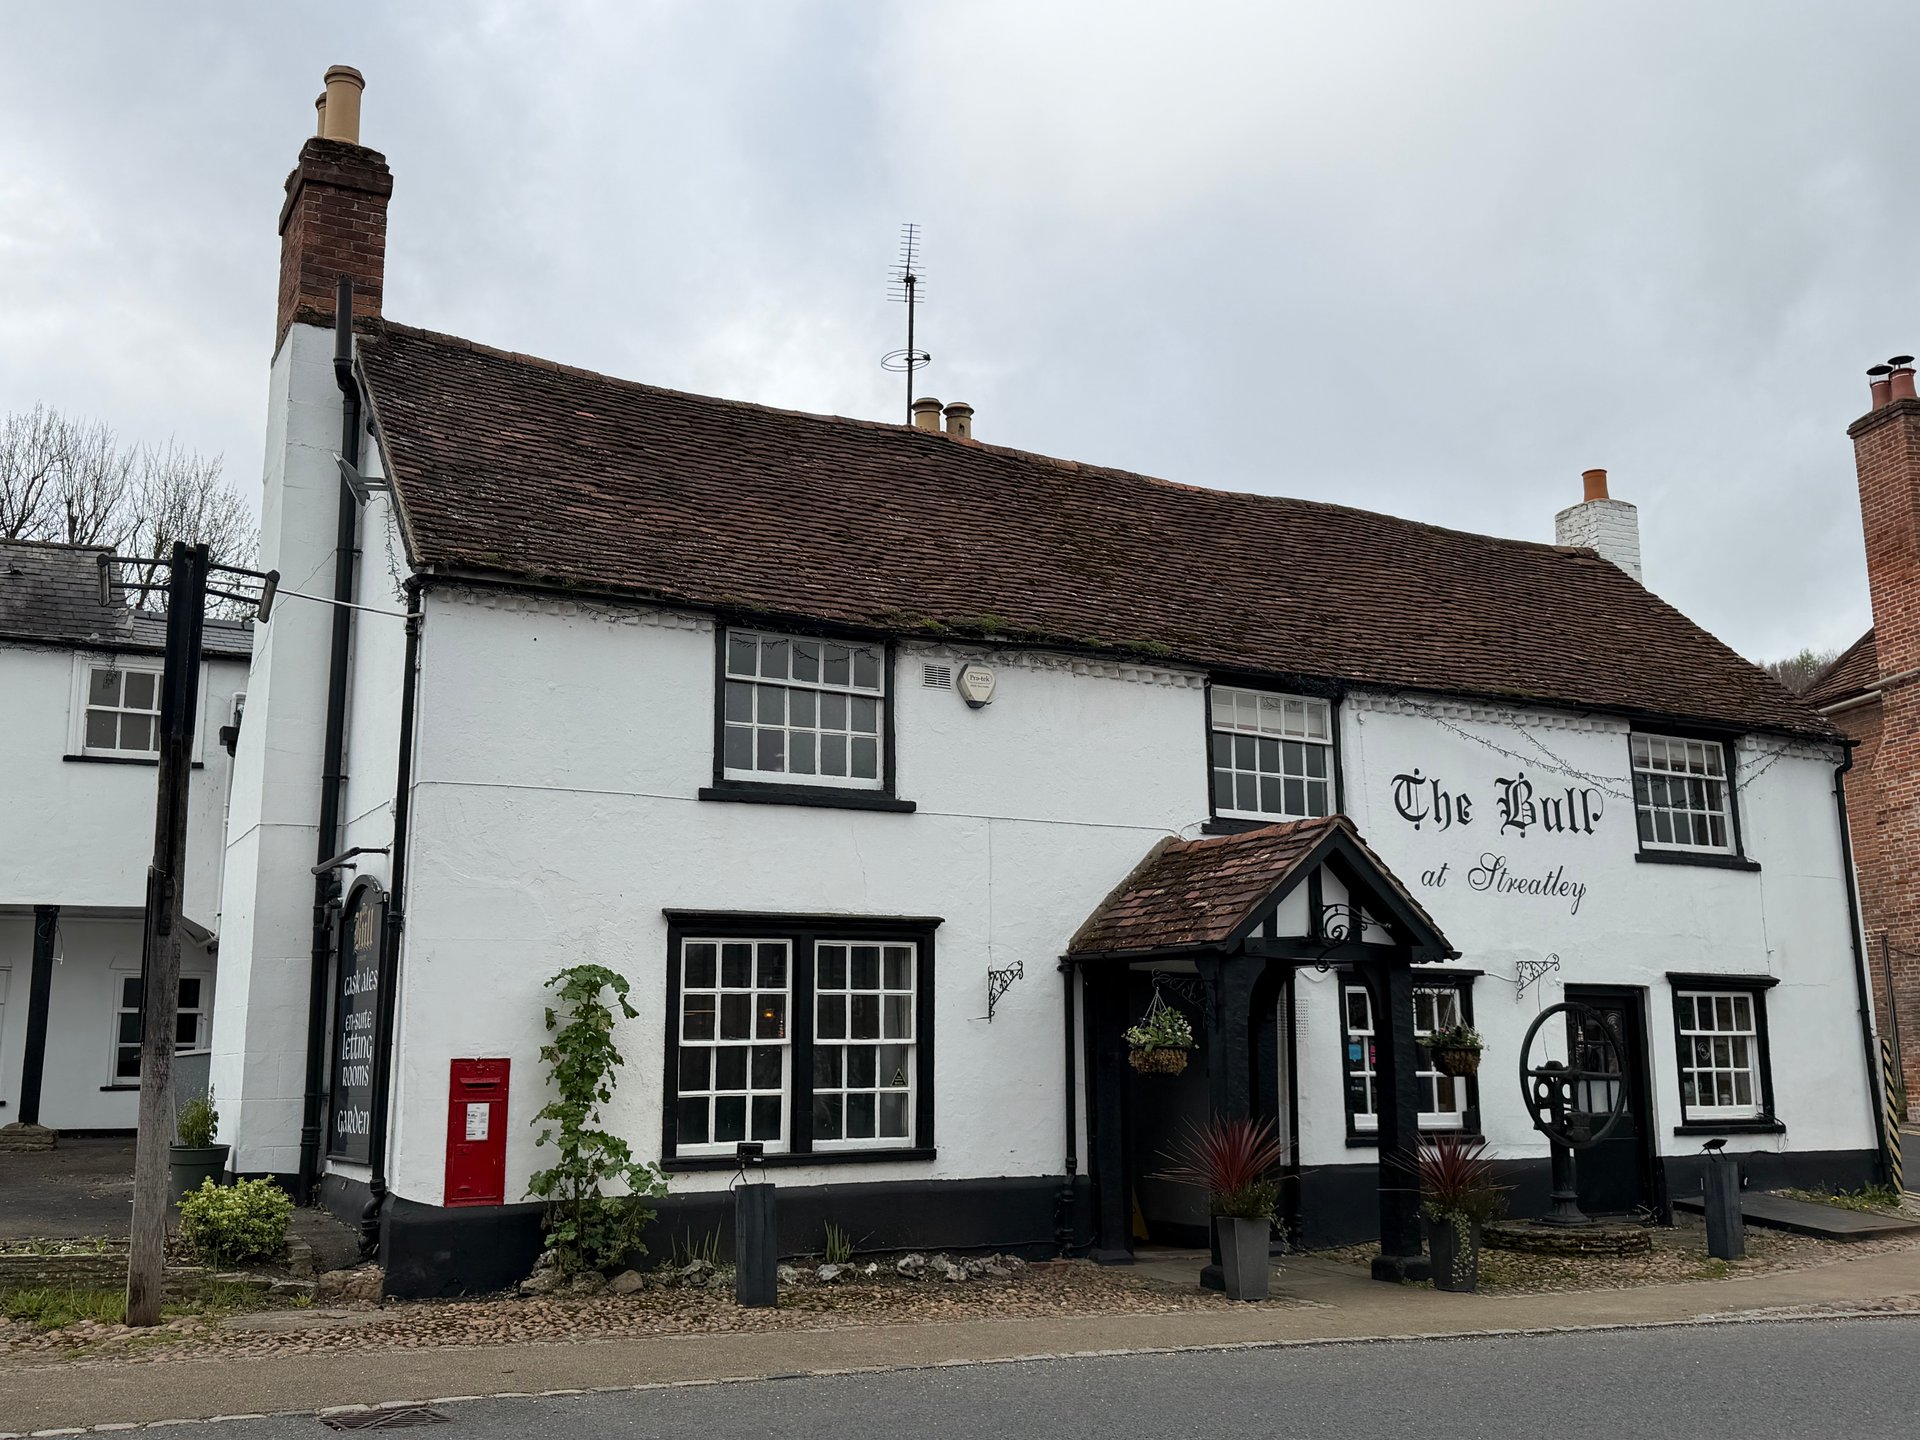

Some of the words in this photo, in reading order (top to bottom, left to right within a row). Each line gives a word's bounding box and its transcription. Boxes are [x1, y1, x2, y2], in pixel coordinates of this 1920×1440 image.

[1390, 768, 1474, 832] The
[1494, 771, 1604, 839] Bull
[1421, 862, 1451, 888] at
[1467, 852, 1587, 915] Streatley
[344, 969, 361, 996] cask
[361, 967, 379, 992] ales
